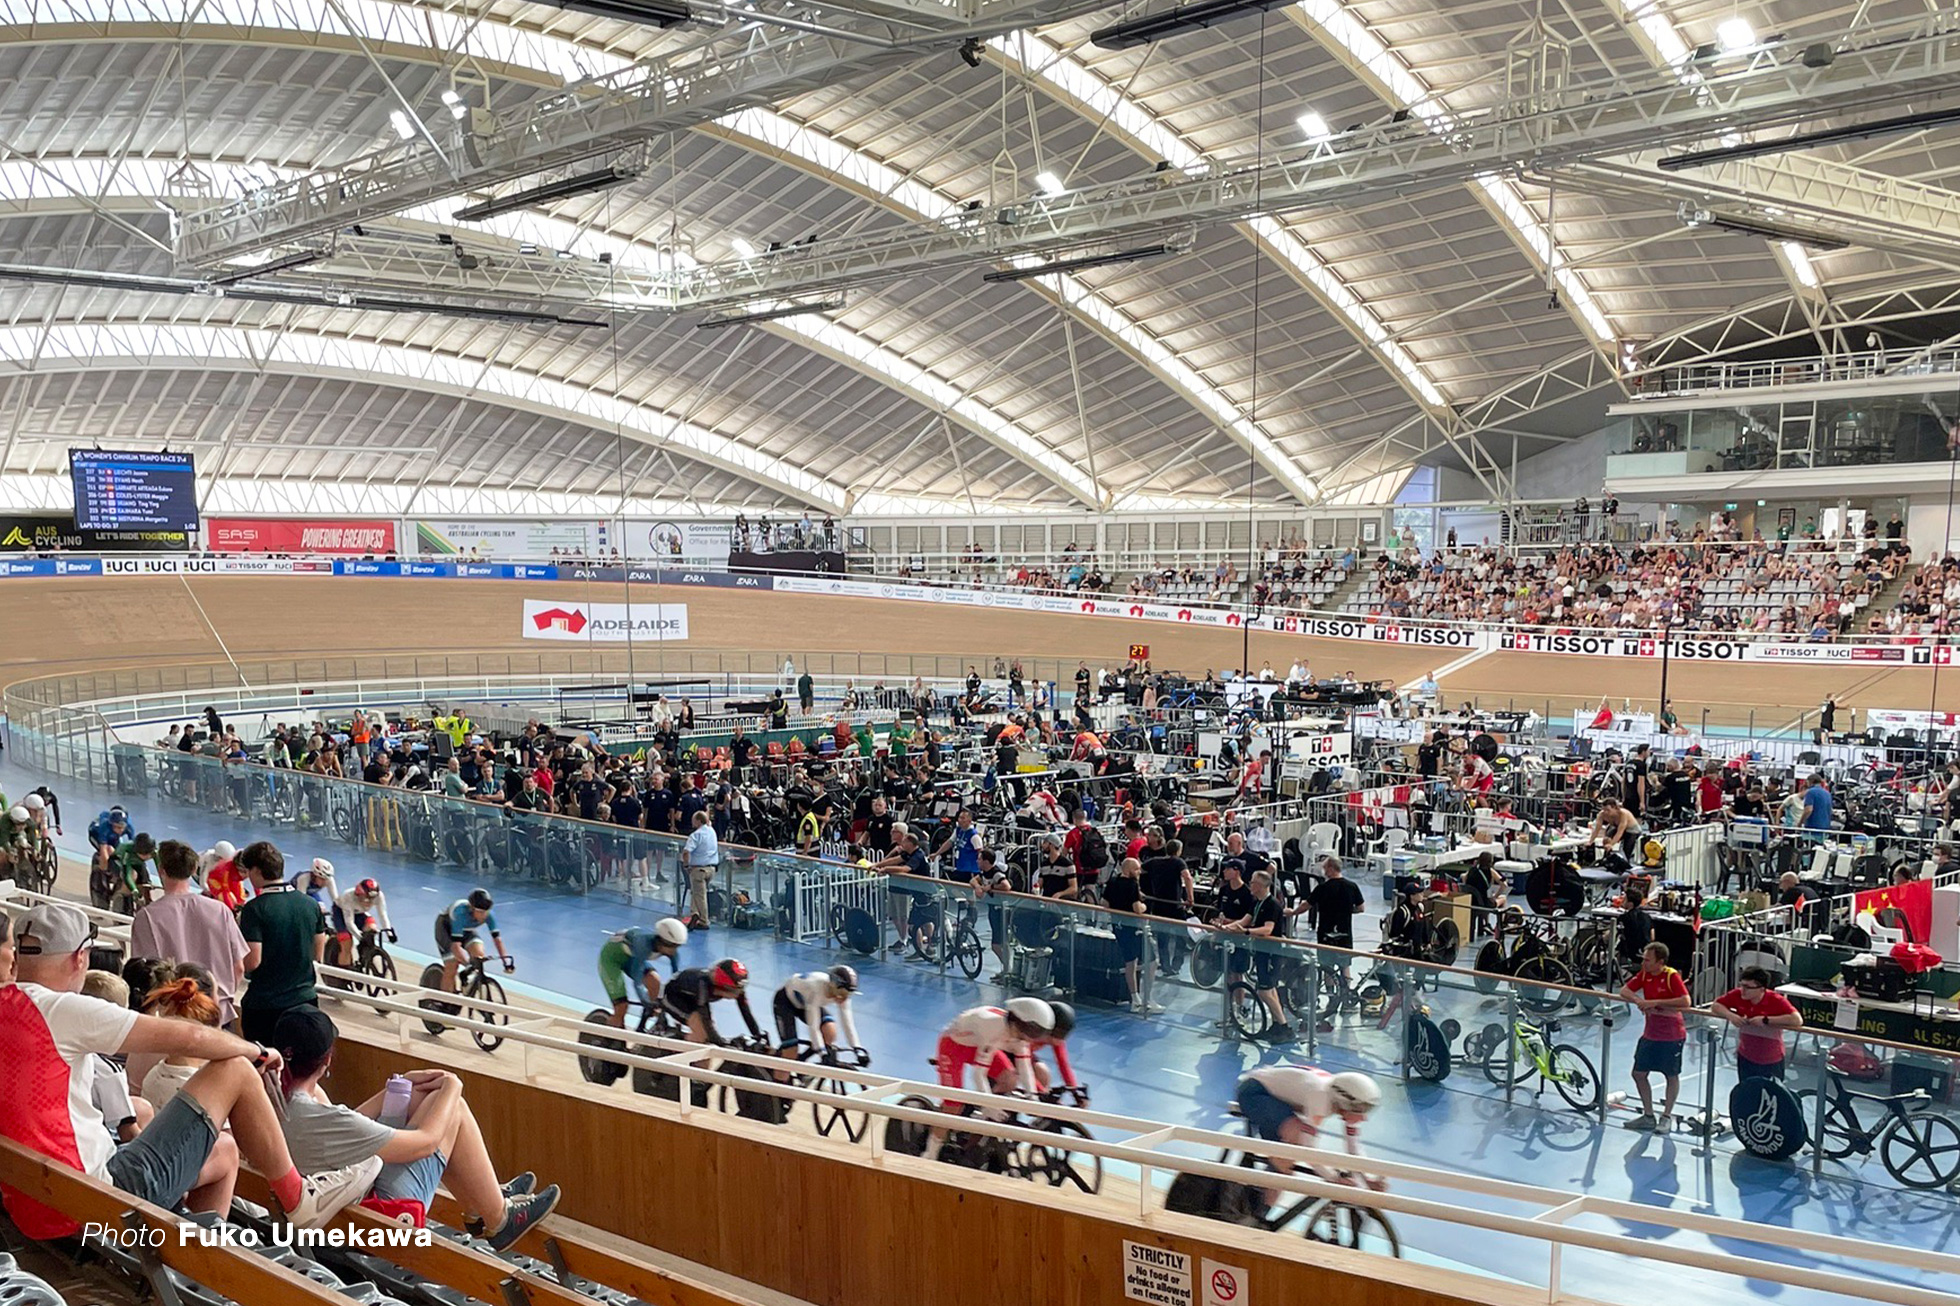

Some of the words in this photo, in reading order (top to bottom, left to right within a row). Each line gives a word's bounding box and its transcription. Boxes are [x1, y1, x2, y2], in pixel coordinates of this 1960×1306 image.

[35, 526, 57, 536] AUS
[140, 532, 185, 541] TOGETHER
[218, 529, 258, 540] SASI
[35, 535, 82, 546] CYCLING
[301, 528, 343, 549] POWERING
[342, 528, 386, 549] GREATNESS
[112, 561, 138, 572] UCI
[151, 561, 177, 572] UCI
[189, 561, 216, 572] UCI
[1096, 606, 1121, 614] ADELAIDE
[1144, 610, 1169, 618] ADELAIDE
[1192, 614, 1217, 622] ADELAIDE
[591, 619, 680, 630] ADELAIDE
[1300, 619, 1366, 638] TISSOT
[1402, 627, 1475, 646] TISSOT
[1533, 635, 1614, 655] TISSOT
[1131, 646, 1144, 656] 27
[1780, 648, 1819, 657] TISSOT
[1832, 649, 1850, 658] UCI
[1131, 1244, 1184, 1270] STRICTLY
[1136, 1265, 1148, 1276] No
[1149, 1269, 1169, 1282] food
[1170, 1276, 1180, 1285] or
[1127, 1274, 1155, 1289] drinks
[1156, 1282, 1191, 1299] allowed
[1133, 1287, 1143, 1297] on
[1145, 1289, 1169, 1304] fence
[1171, 1296, 1186, 1306] top
